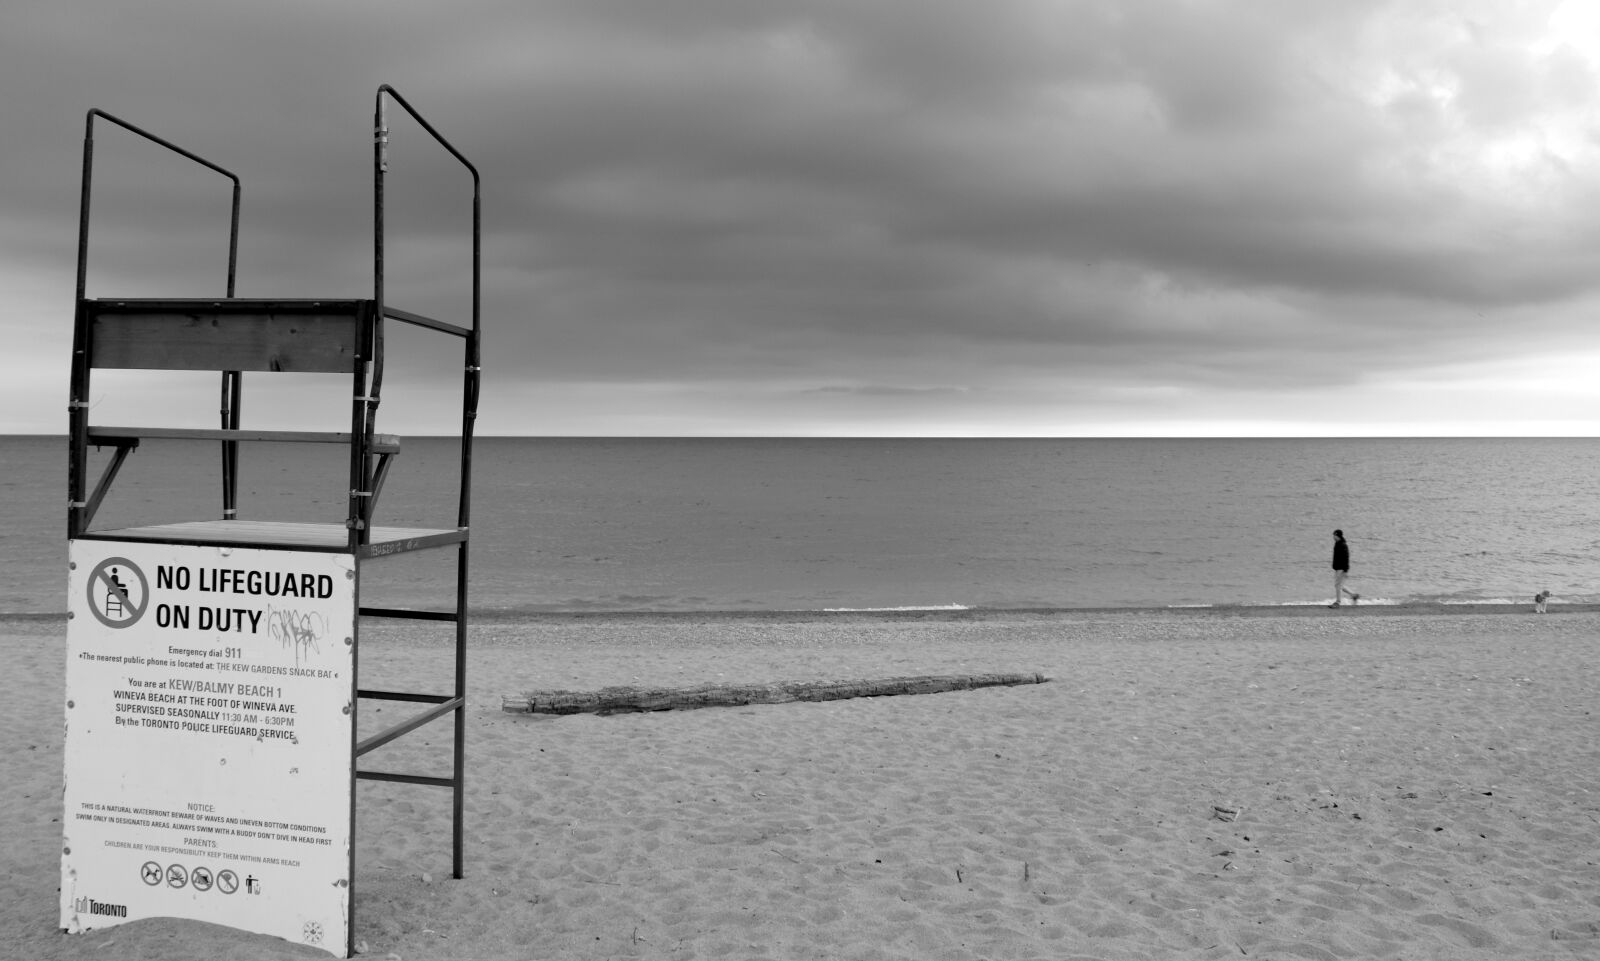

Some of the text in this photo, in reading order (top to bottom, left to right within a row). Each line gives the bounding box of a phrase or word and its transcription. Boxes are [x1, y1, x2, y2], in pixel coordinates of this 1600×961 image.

[157, 566, 333, 599] NO LIFEGUARD
[156, 604, 189, 629] ON
[199, 607, 262, 633] DUTY
[169, 646, 207, 658] Emergency
[225, 648, 241, 658] 911
[147, 658, 167, 666] phone
[178, 660, 203, 669] located
[232, 664, 249, 672] KEW
[252, 665, 287, 675] GARDENS
[289, 668, 315, 677] SNACK
[129, 678, 142, 687] You
[169, 679, 234, 694] KEW/BALMY
[238, 684, 273, 697] BEACH
[277, 688, 281, 698] 1
[114, 690, 146, 700] WINEVA
[149, 693, 175, 703] BEACH
[177, 696, 187, 704] AT
[190, 697, 204, 706] THE
[208, 698, 228, 708] FOOT
[231, 700, 240, 708] OF
[243, 702, 276, 712] WINEVA
[116, 704, 165, 716] SUPERVISED
[168, 708, 219, 720] SEASONALLY
[222, 713, 241, 721] 11:30
[244, 715, 257, 723] AM
[265, 716, 294, 726] 6:30PM
[116, 716, 125, 726] By
[128, 718, 139, 726] the
[142, 719, 179, 730] TORONTO
[182, 722, 209, 732] POLICE
[212, 725, 257, 736] LIFEGUARD
[107, 805, 131, 813] NATURAL
[133, 808, 170, 817] WATERFRONT
[172, 812, 195, 820] BEWARE
[240, 819, 262, 827] UNEVEN
[290, 824, 326, 833] CONDITIONS
[116, 817, 150, 826] DESIGNATED
[105, 840, 131, 849] CHILDREN
[161, 846, 206, 856] RESPONSIBILITY
[89, 899, 126, 917] TORONTO
